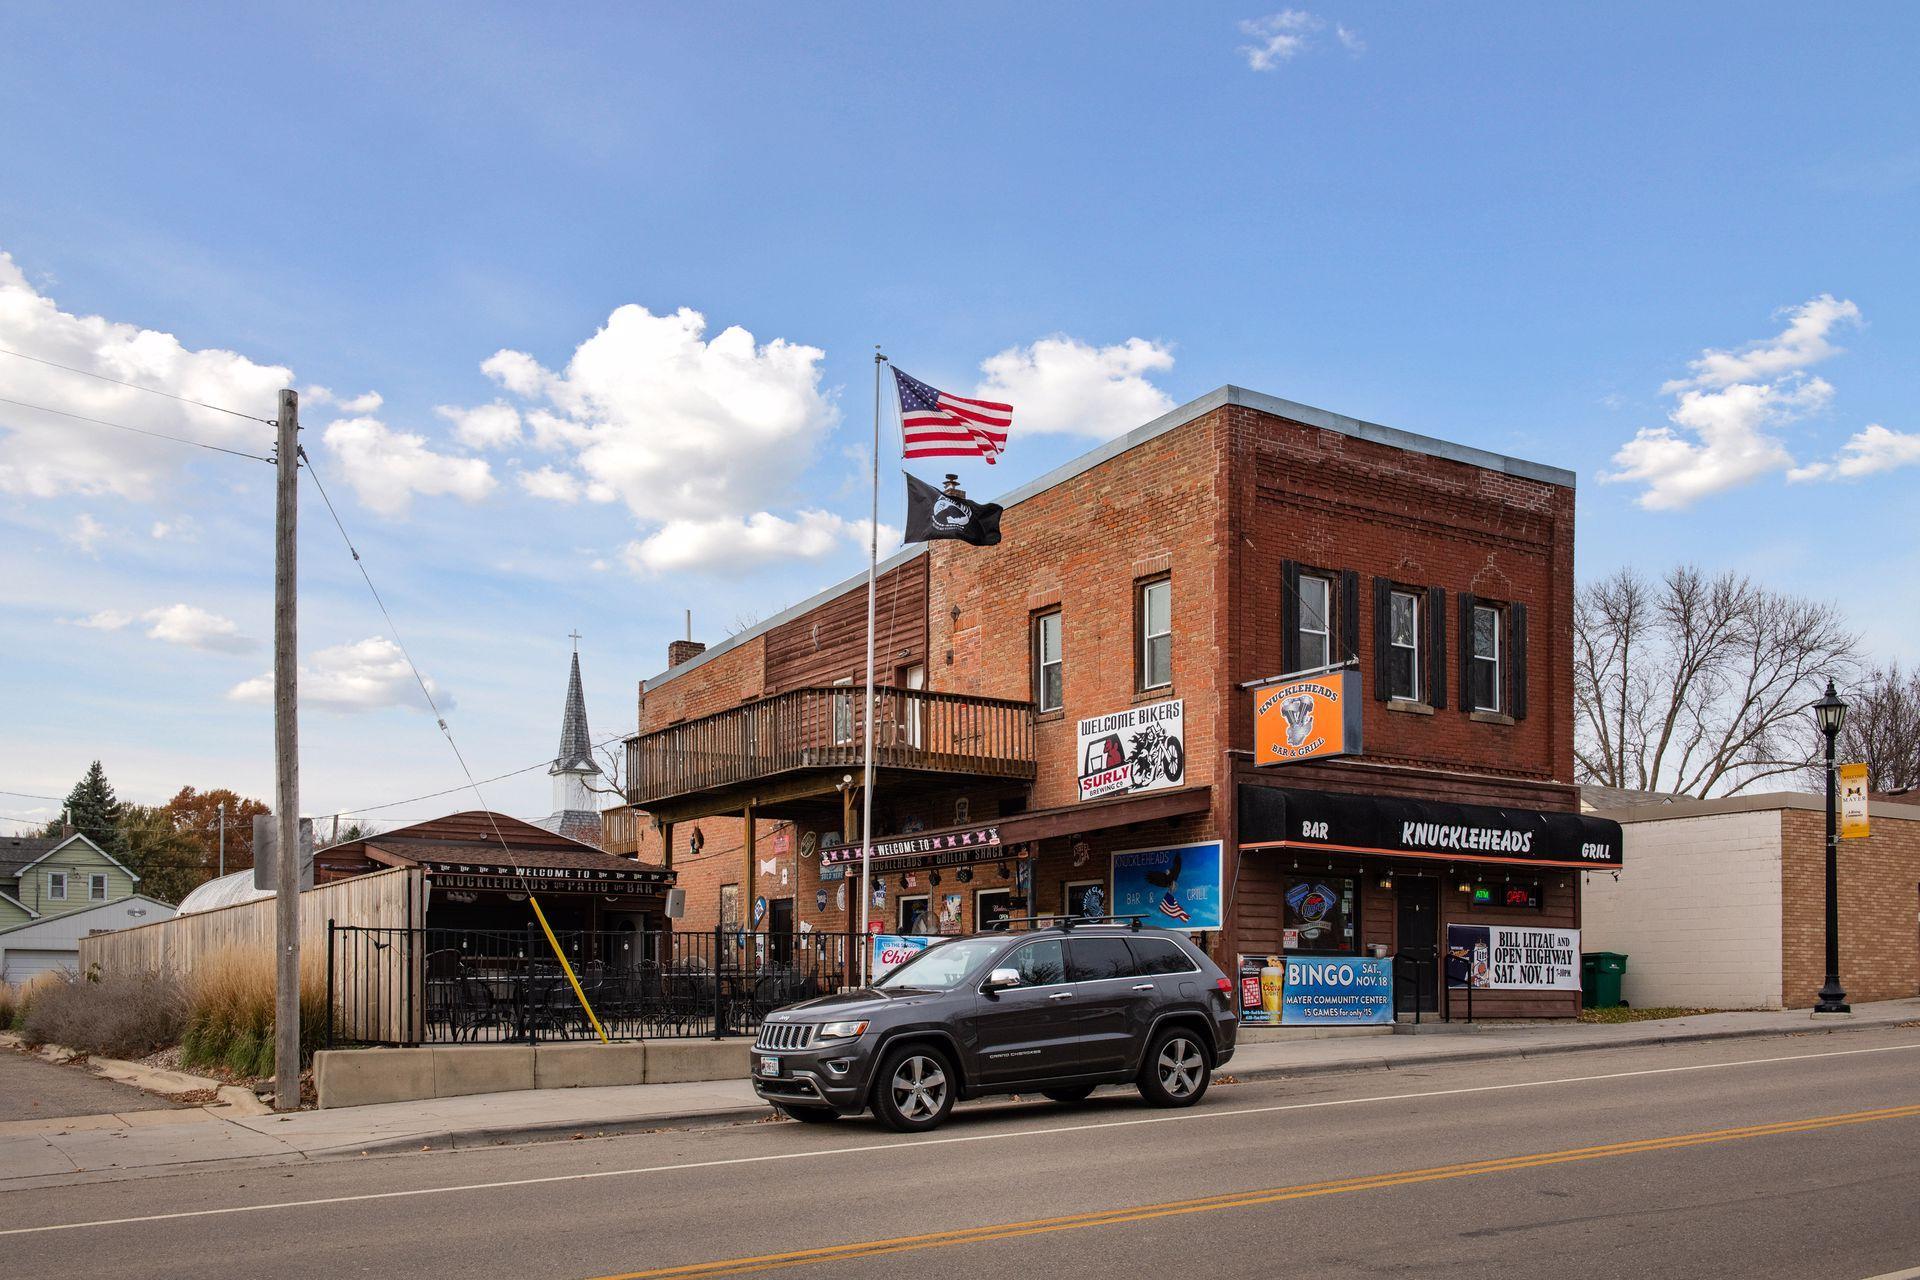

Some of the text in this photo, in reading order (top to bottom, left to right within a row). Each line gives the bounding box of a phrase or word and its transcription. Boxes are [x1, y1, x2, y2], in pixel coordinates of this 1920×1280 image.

[1258, 684, 1338, 715] KNUCKLEHEADS
[1081, 702, 1180, 736] WELCOME BIKERS
[1272, 738, 1325, 757] BAR & GRILL
[1083, 765, 1130, 790] SURLY
[1089, 784, 1115, 797] BREWING
[877, 839, 930, 856] WELCOME TO
[1302, 820, 1611, 859] BAR KNUCKLEHEADS GRILL
[1114, 851, 1170, 867] KNUCKLEHEADS
[516, 867, 571, 878] WELCOME
[577, 870, 590, 879] TO
[436, 875, 548, 890] KNUCKLEHEADS
[567, 881, 608, 892] PATIO
[627, 883, 652, 894] BAR
[1126, 892, 1141, 905] BAR
[1186, 887, 1208, 901] GRILL
[1475, 890, 1489, 899] ATM
[1506, 890, 1528, 904] OPEN
[1498, 931, 1570, 949] BILL LITZAU AND
[1494, 947, 1573, 965] OPEN HIGHWAY
[1289, 964, 1354, 986] BINGO
[1356, 976, 1388, 986] NOV. 18
[1494, 964, 1517, 984] SAT.
[1519, 965, 1543, 984] NOV.
[1546, 966, 1555, 984] 11
[1262, 982, 1281, 992] Coors
[1286, 995, 1388, 1004] MAYER COMMUNITY CENTER
[1304, 1008, 1311, 1016] 15
[1312, 1008, 1338, 1016] GAMES
[1339, 1008, 1348, 1016] for
[1349, 1009, 1362, 1018] only
